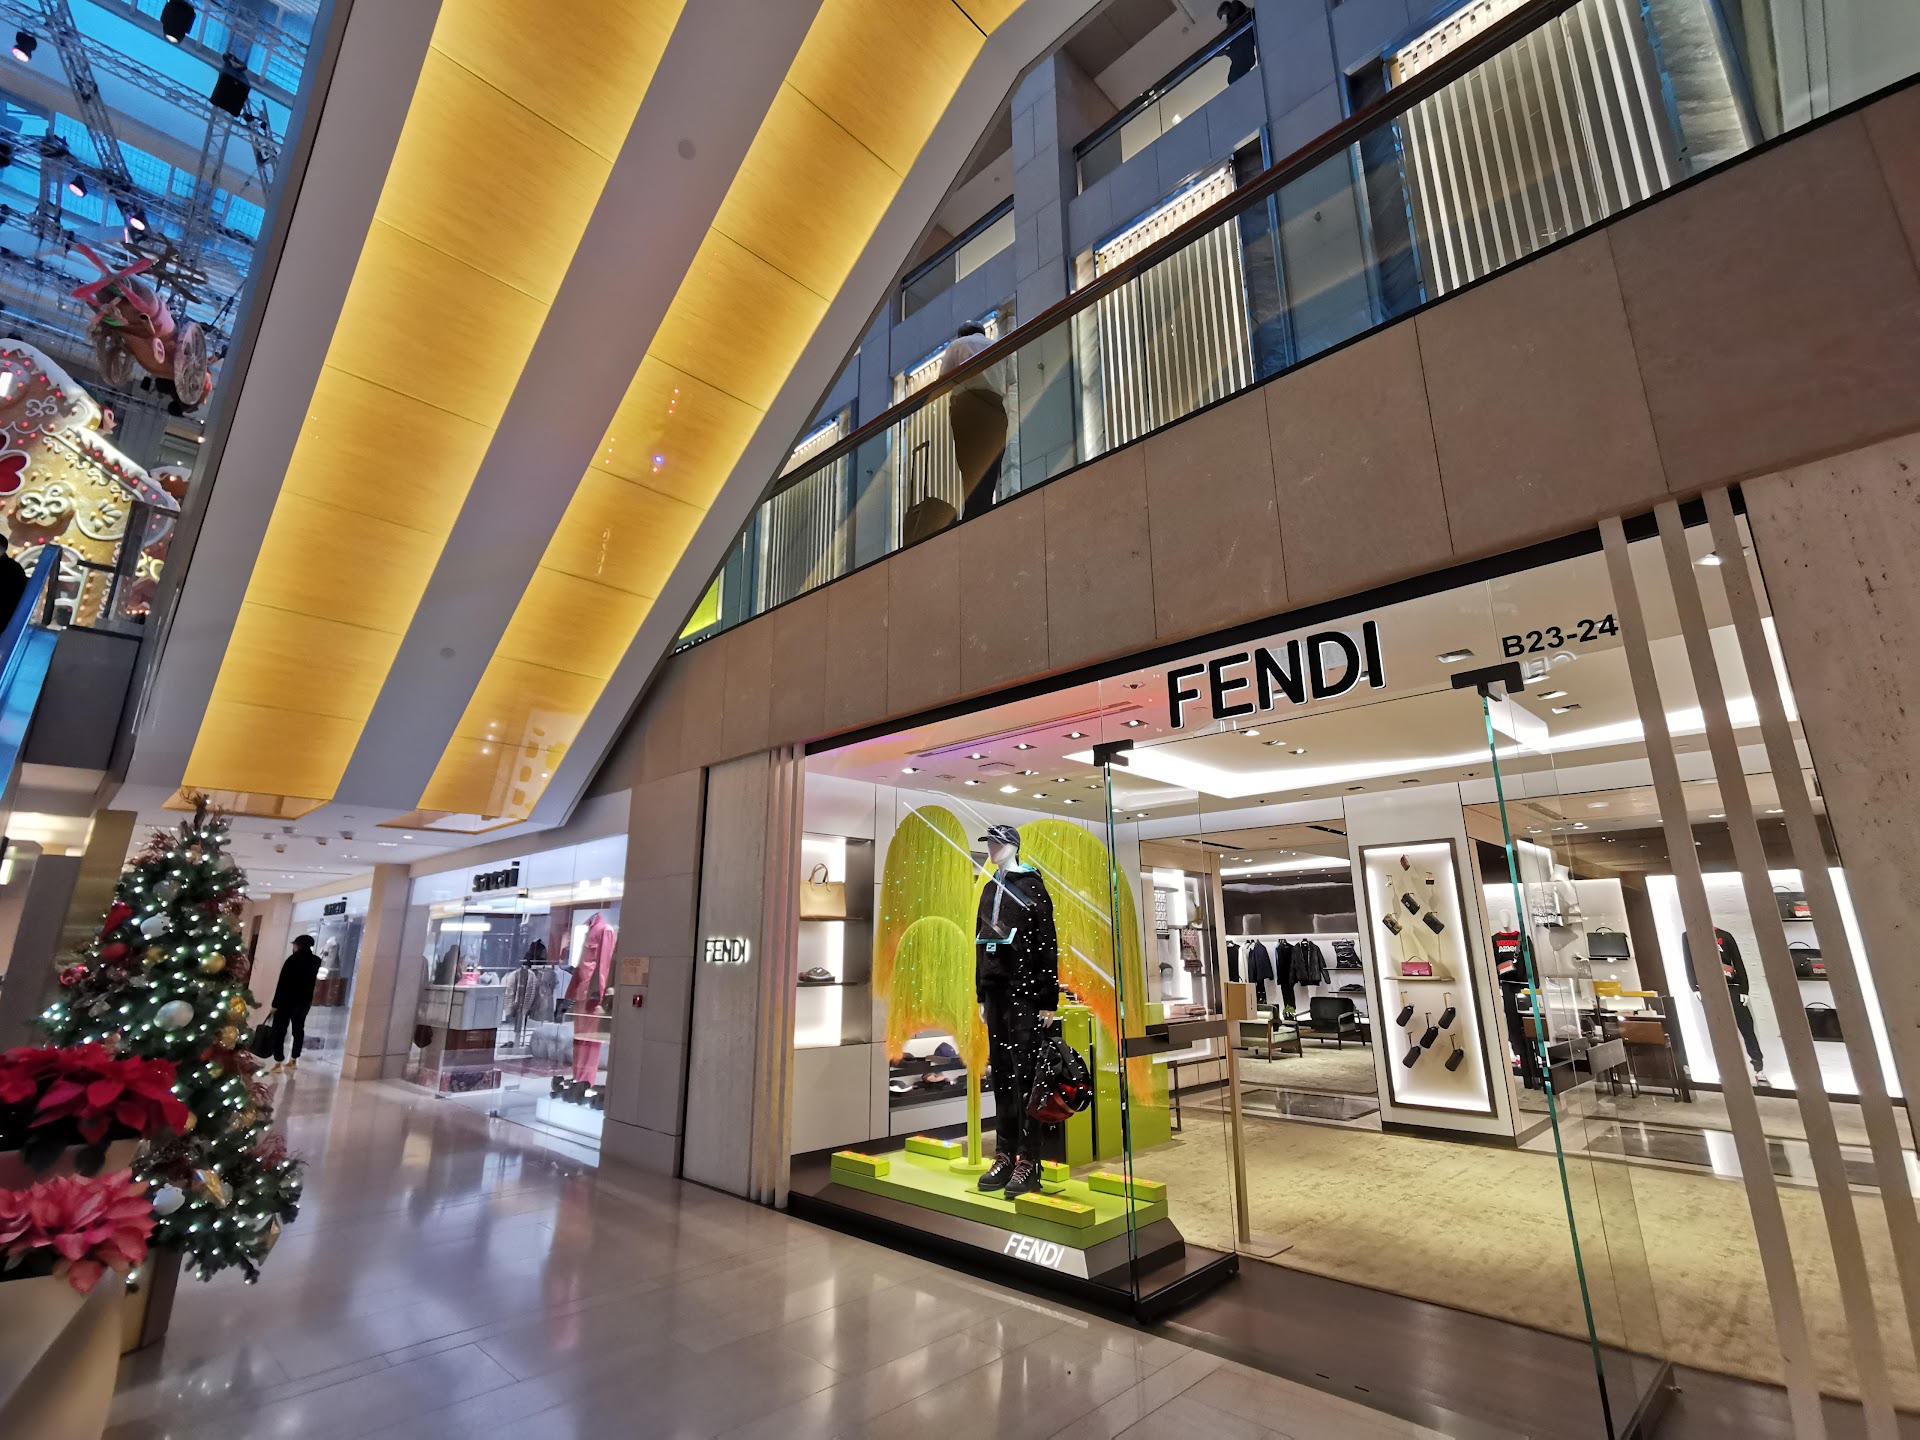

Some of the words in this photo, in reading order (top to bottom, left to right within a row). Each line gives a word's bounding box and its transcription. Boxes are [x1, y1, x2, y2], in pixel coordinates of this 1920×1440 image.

[1502, 614, 1619, 658] B23-24
[1167, 620, 1387, 729] FENDI
[704, 937, 750, 964] FENDI
[1003, 1232, 1065, 1268] FENDI
